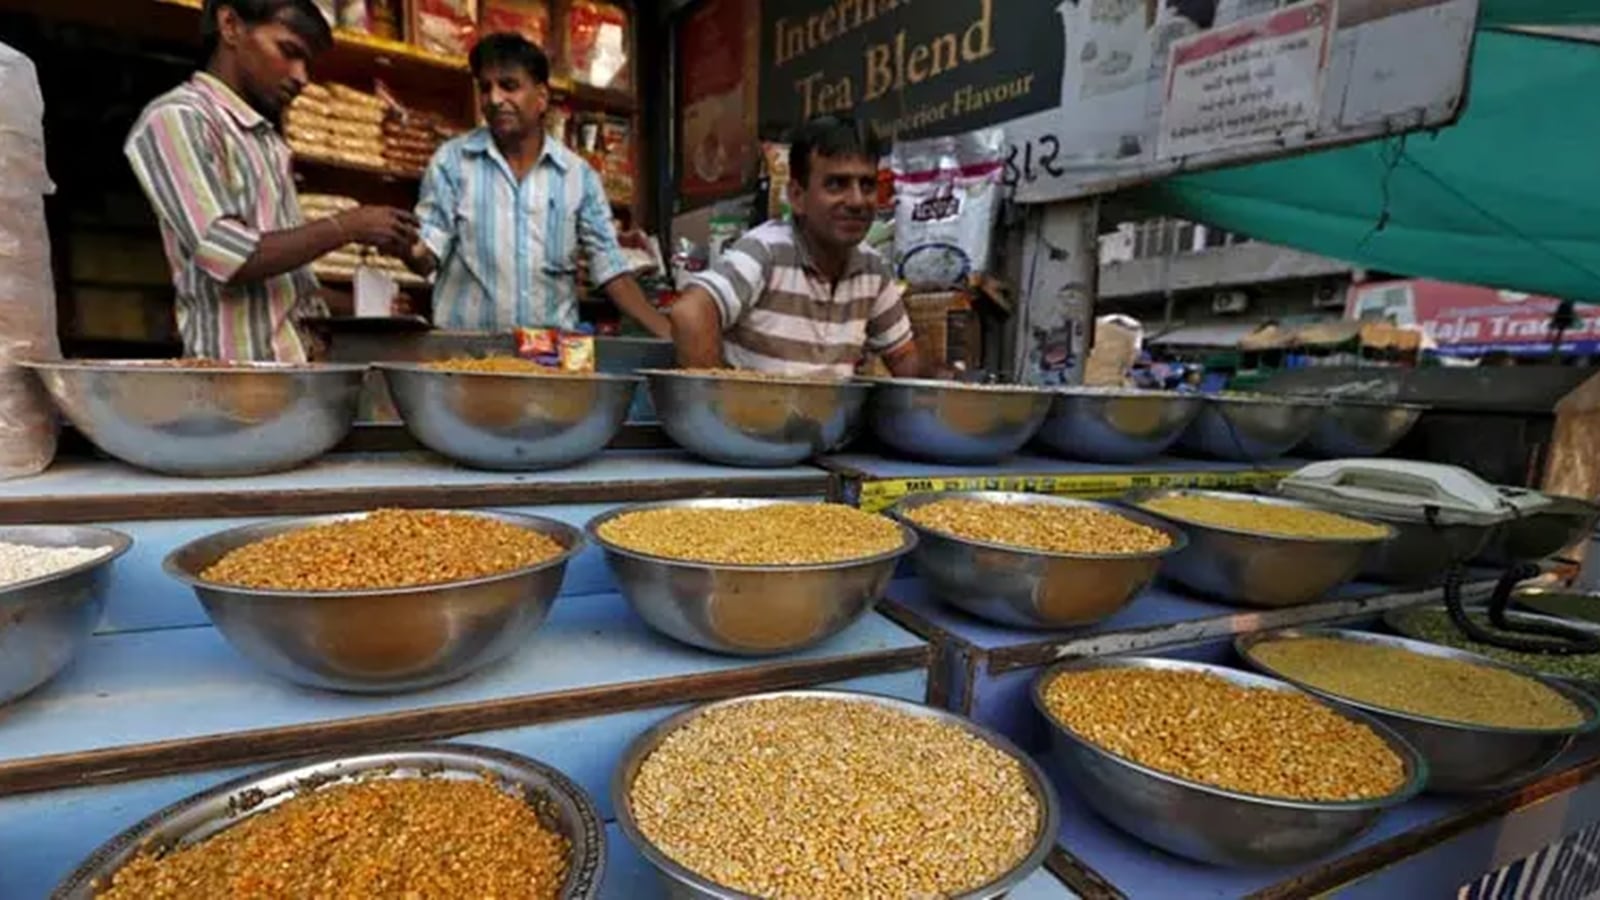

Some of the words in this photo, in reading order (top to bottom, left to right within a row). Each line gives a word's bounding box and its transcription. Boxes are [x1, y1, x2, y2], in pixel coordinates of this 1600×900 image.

[795, 72, 854, 119] Tea
[864, 0, 994, 101] Blend
[952, 73, 1035, 116] Flavour
[906, 481, 934, 491] TATA
